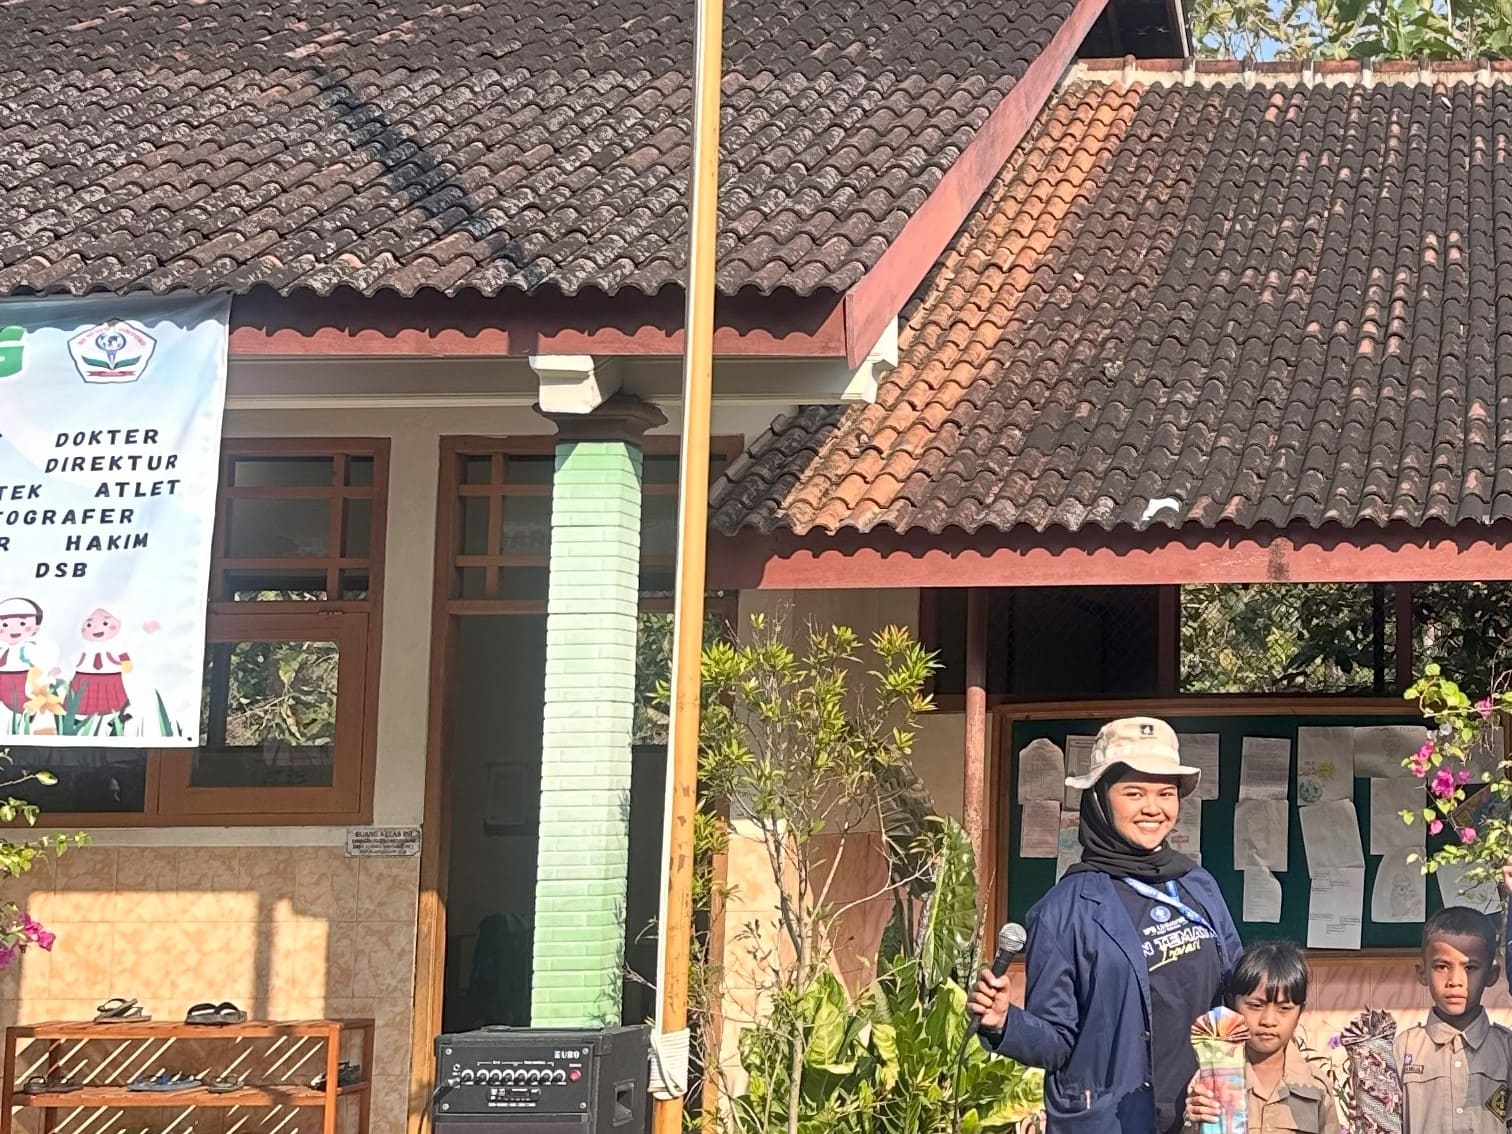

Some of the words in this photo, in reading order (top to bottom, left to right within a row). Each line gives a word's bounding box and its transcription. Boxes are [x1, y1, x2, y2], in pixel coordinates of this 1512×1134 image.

[55, 429, 159, 447] DOKTER
[45, 454, 178, 473] DIREKTUR
[94, 480, 181, 497] ATLET
[0, 508, 134, 525] OGRAFER
[65, 532, 149, 551] HAKIM
[35, 562, 88, 578] DSB
